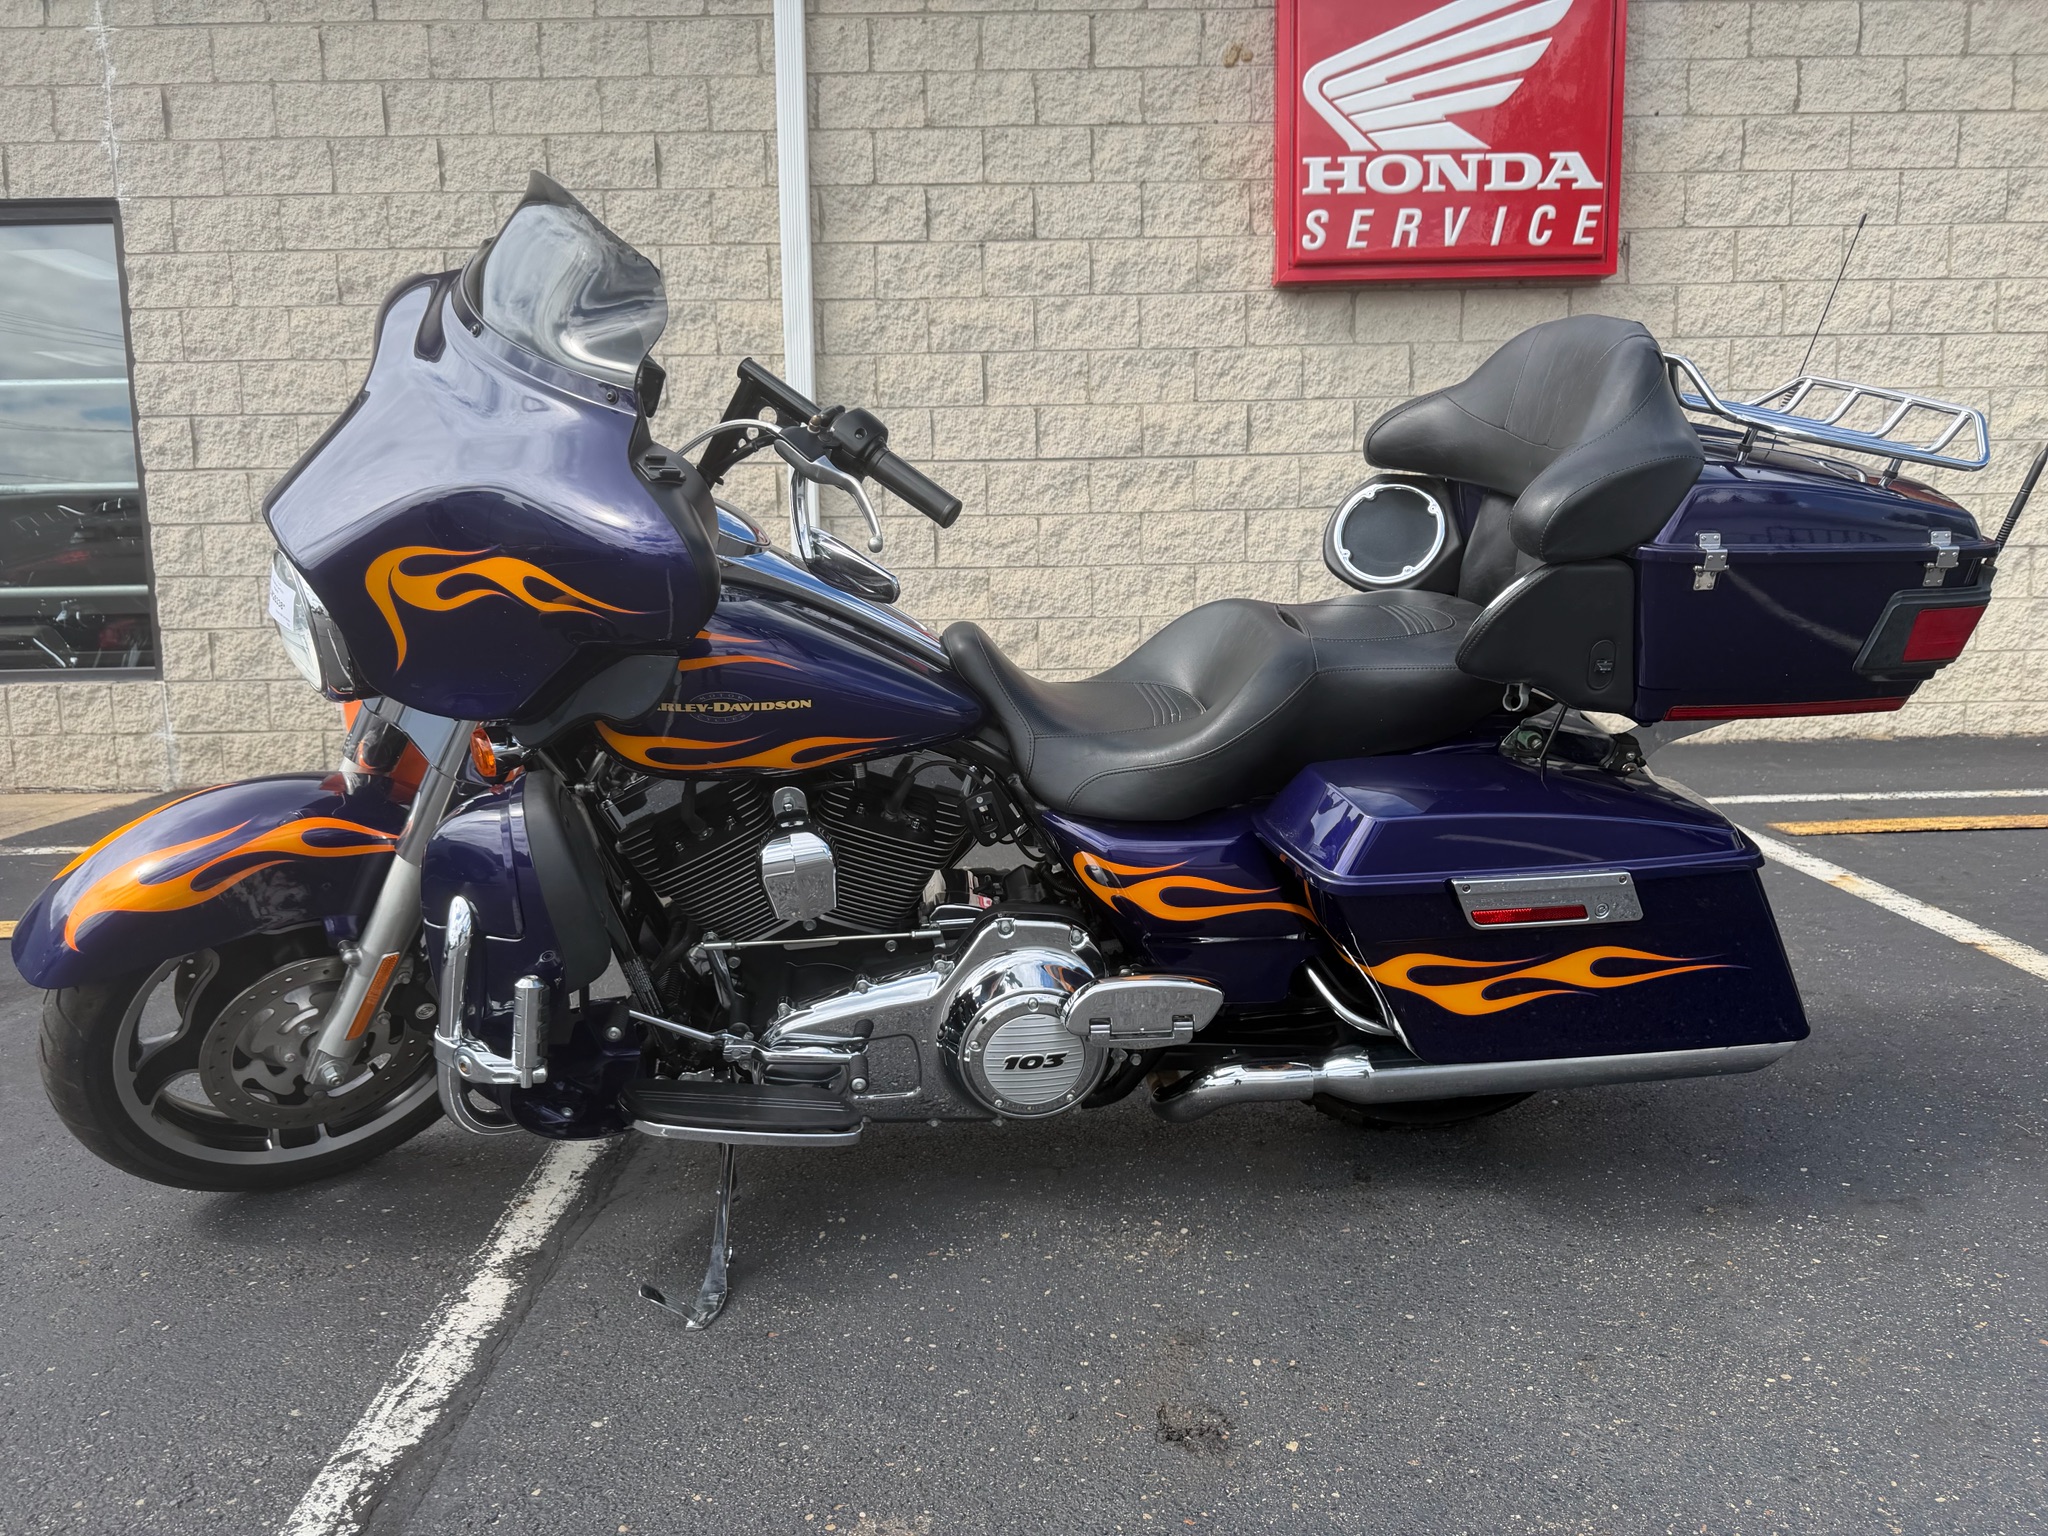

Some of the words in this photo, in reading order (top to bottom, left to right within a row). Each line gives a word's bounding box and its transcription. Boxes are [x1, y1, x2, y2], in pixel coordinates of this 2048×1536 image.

[1302, 151, 1603, 195] HONDA
[1301, 204, 1602, 250] SERVICE
[657, 699, 812, 713] RLEY-DAVIDSON
[1003, 1051, 1069, 1071] 103
